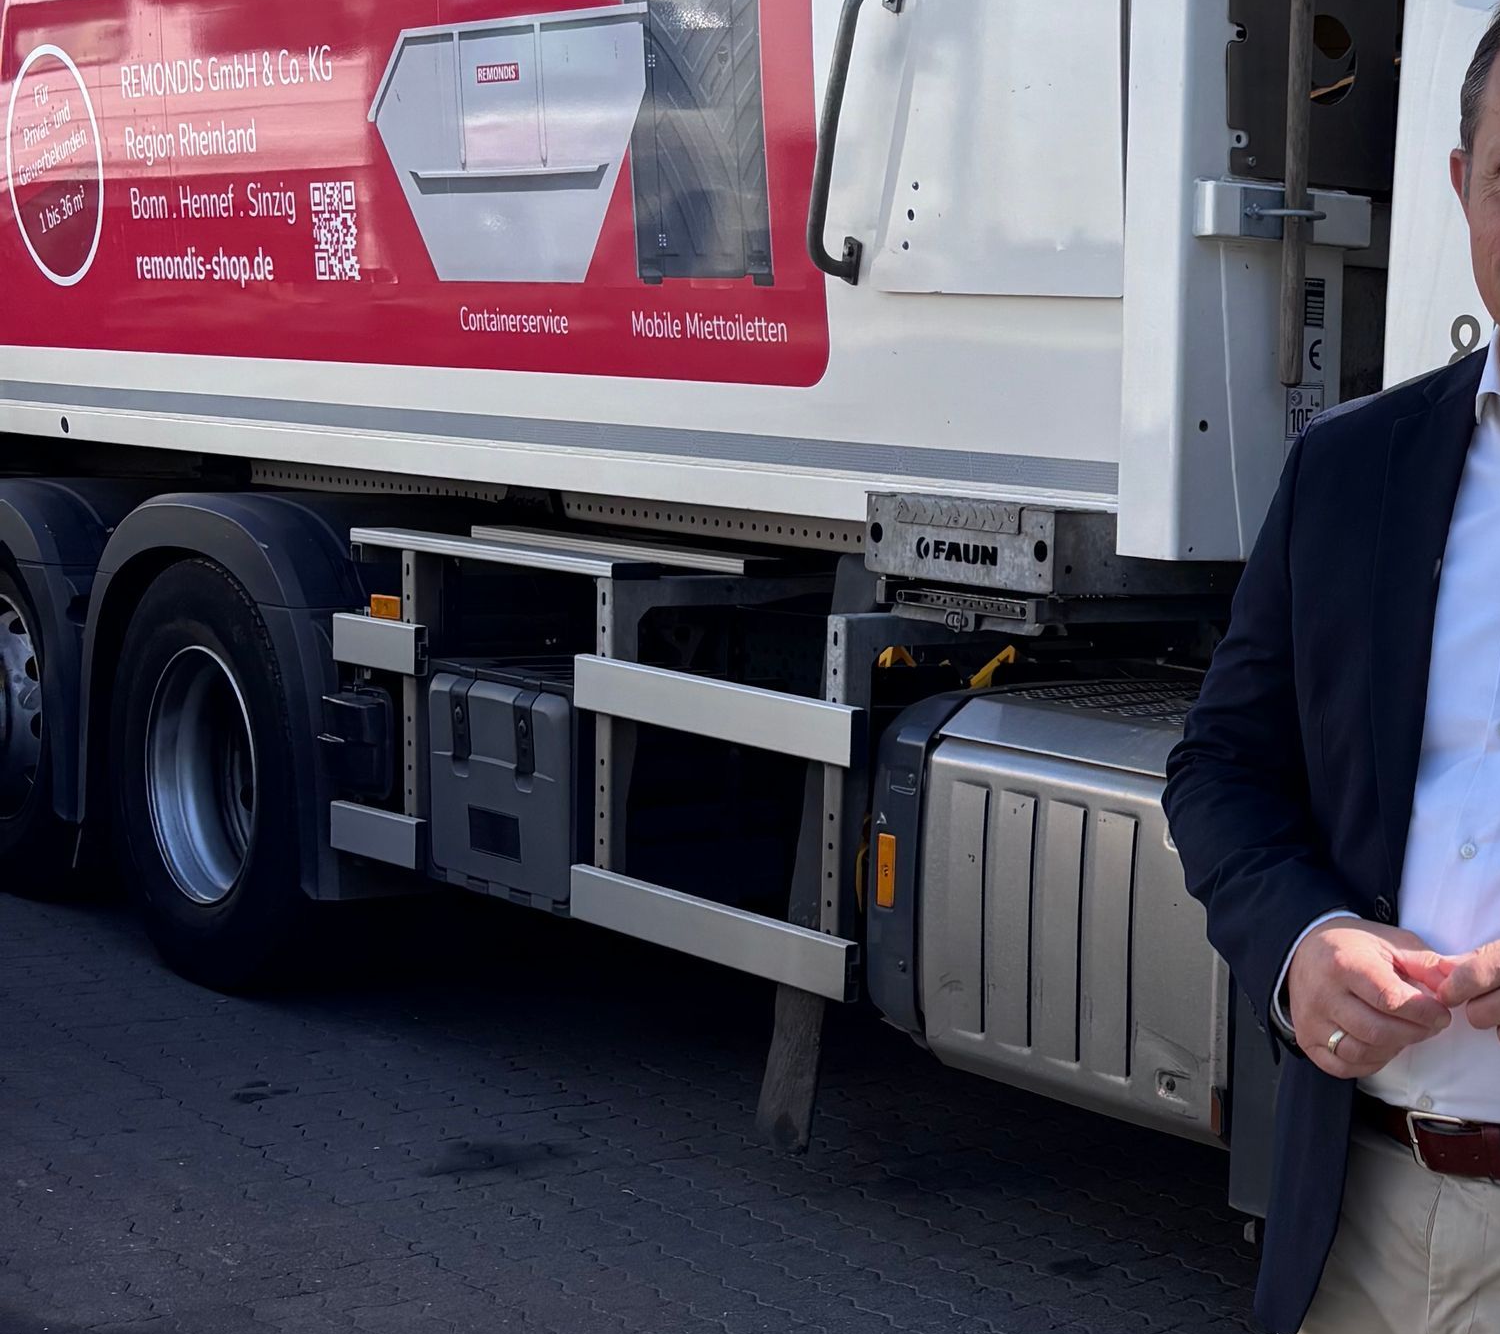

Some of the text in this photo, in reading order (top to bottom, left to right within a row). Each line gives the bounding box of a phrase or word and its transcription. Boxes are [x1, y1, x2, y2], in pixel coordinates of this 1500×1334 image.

[121, 44, 334, 99] REMONDIS GmbH & Co. KG
[33, 83, 50, 108] Für
[53, 99, 72, 129] und
[18, 128, 88, 187] Gewerbekunden
[124, 118, 257, 166] Region Rheinland
[46, 204, 61, 229] bis
[60, 194, 74, 221] 36
[130, 186, 168, 220] Bonn
[179, 183, 235, 219] Hennef
[247, 181, 297, 225] Sinzig
[136, 246, 275, 289] remondis-shop.de
[459, 305, 570, 335] Containerservice
[631, 310, 788, 343] Mobile Miettoiletten
[933, 539, 999, 567] FAUN
